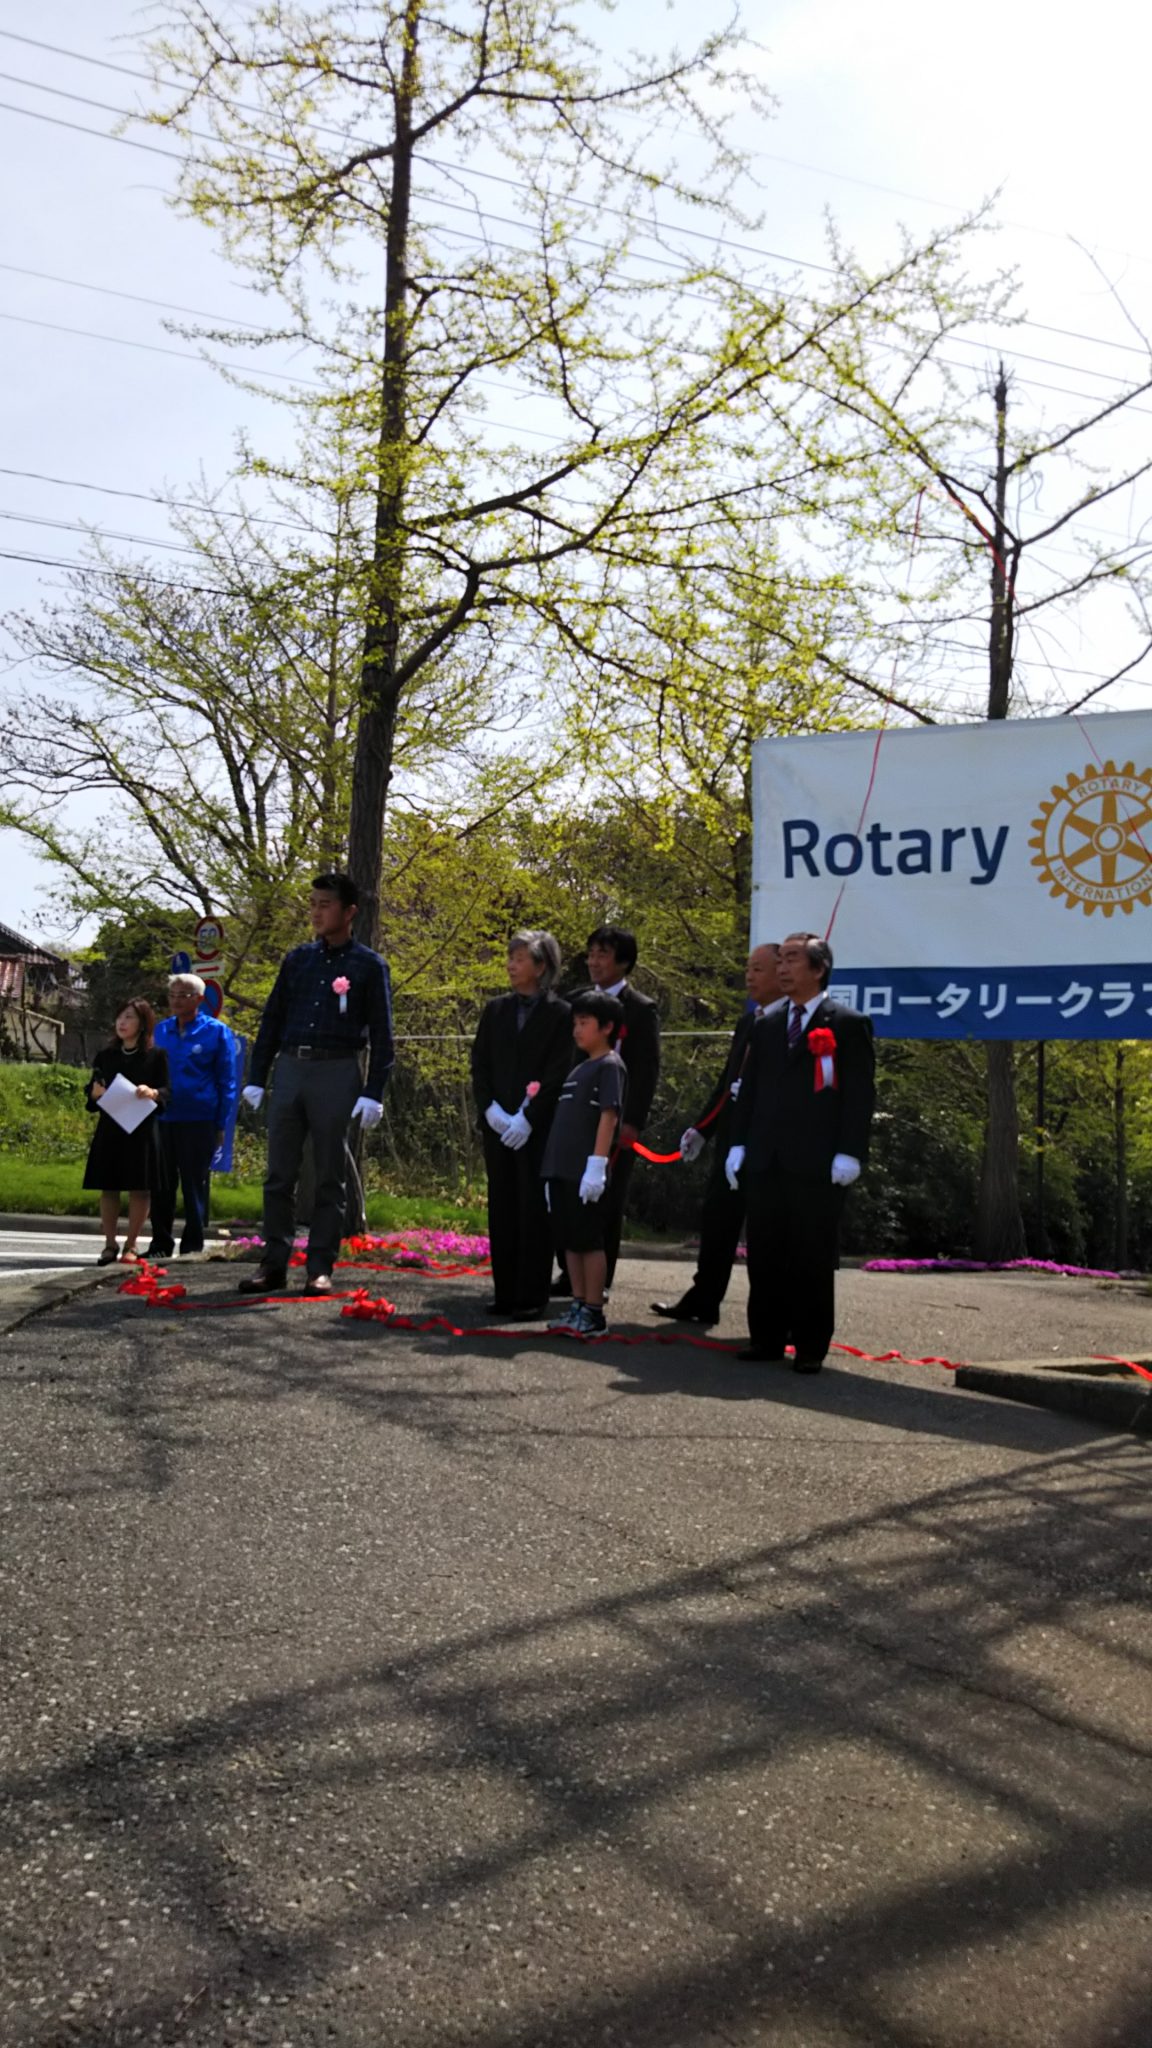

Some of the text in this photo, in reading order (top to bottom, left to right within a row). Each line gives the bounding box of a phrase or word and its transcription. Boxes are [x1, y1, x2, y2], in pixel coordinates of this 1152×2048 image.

[1077, 778, 1143, 798] ROTARY
[782, 819, 1010, 885] Rotary
[1054, 866, 1152, 900] INTERNATION
[827, 981, 1152, 1019] 国ロータリークラ
